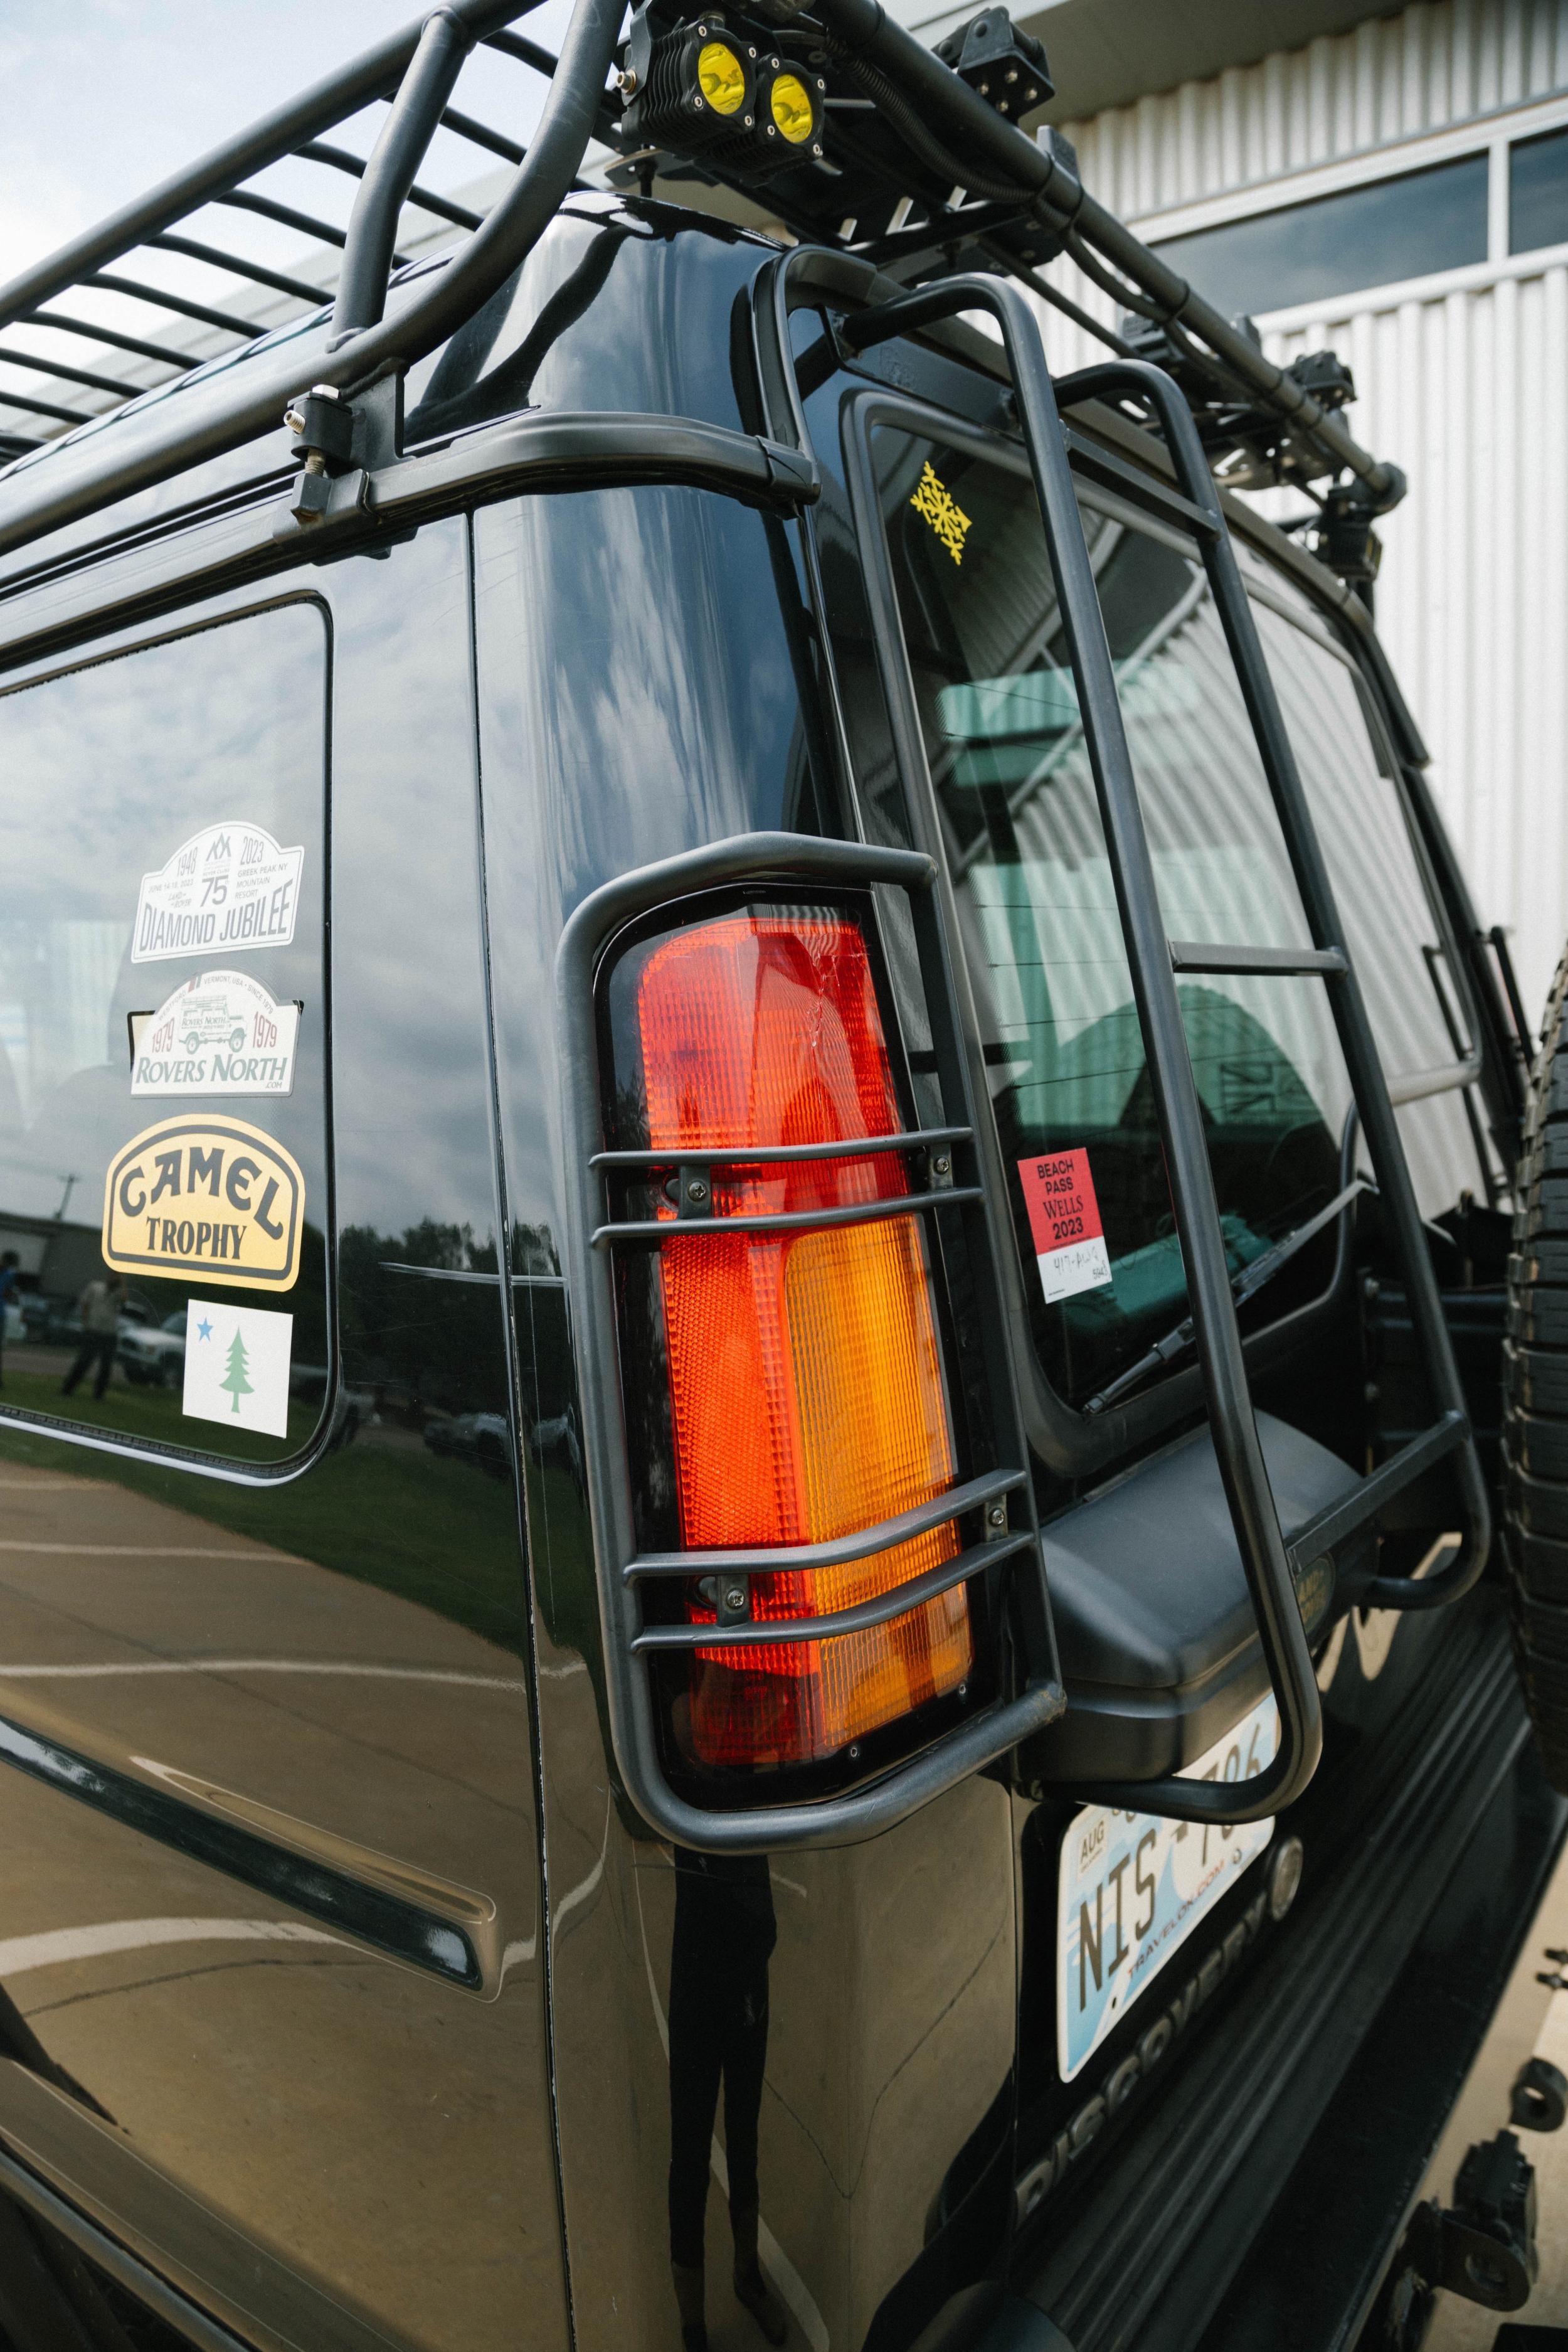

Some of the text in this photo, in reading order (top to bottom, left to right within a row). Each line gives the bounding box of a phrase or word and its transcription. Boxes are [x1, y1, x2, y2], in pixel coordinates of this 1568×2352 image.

[177, 846, 198, 877] 1948
[240, 836, 265, 865] 2023
[236, 876, 270, 888] MOUNTAIN
[238, 862, 289, 878] GREEK PEAK NY
[148, 884, 162, 893] JUNE
[235, 889, 258, 900] RESORT
[139, 878, 294, 951] DIAMOND JUBILEE
[203, 975, 231, 985] VERMONT,
[232, 977, 243, 987] USA
[247, 984, 263, 1002] SINCE
[262, 998, 274, 1014] 1979
[152, 1017, 175, 1053] 1979
[181, 1016, 226, 1026] ROVERS NORTH
[252, 1011, 278, 1049] 1979
[135, 1053, 288, 1084] ROVERS NORTH
[265, 1081, 282, 1089] .COM
[1037, 1159, 1074, 1179] BEACH
[119, 1146, 284, 1240] CAMEL
[1046, 1176, 1074, 1195] PASS
[1043, 1195, 1084, 1220] WELLS
[146, 1216, 248, 1260] TROPHY
[1052, 1217, 1084, 1240] 2023
[1080, 1820, 1104, 1864] AUG
[1128, 1858, 1225, 1979] TRAVELOK.COM
